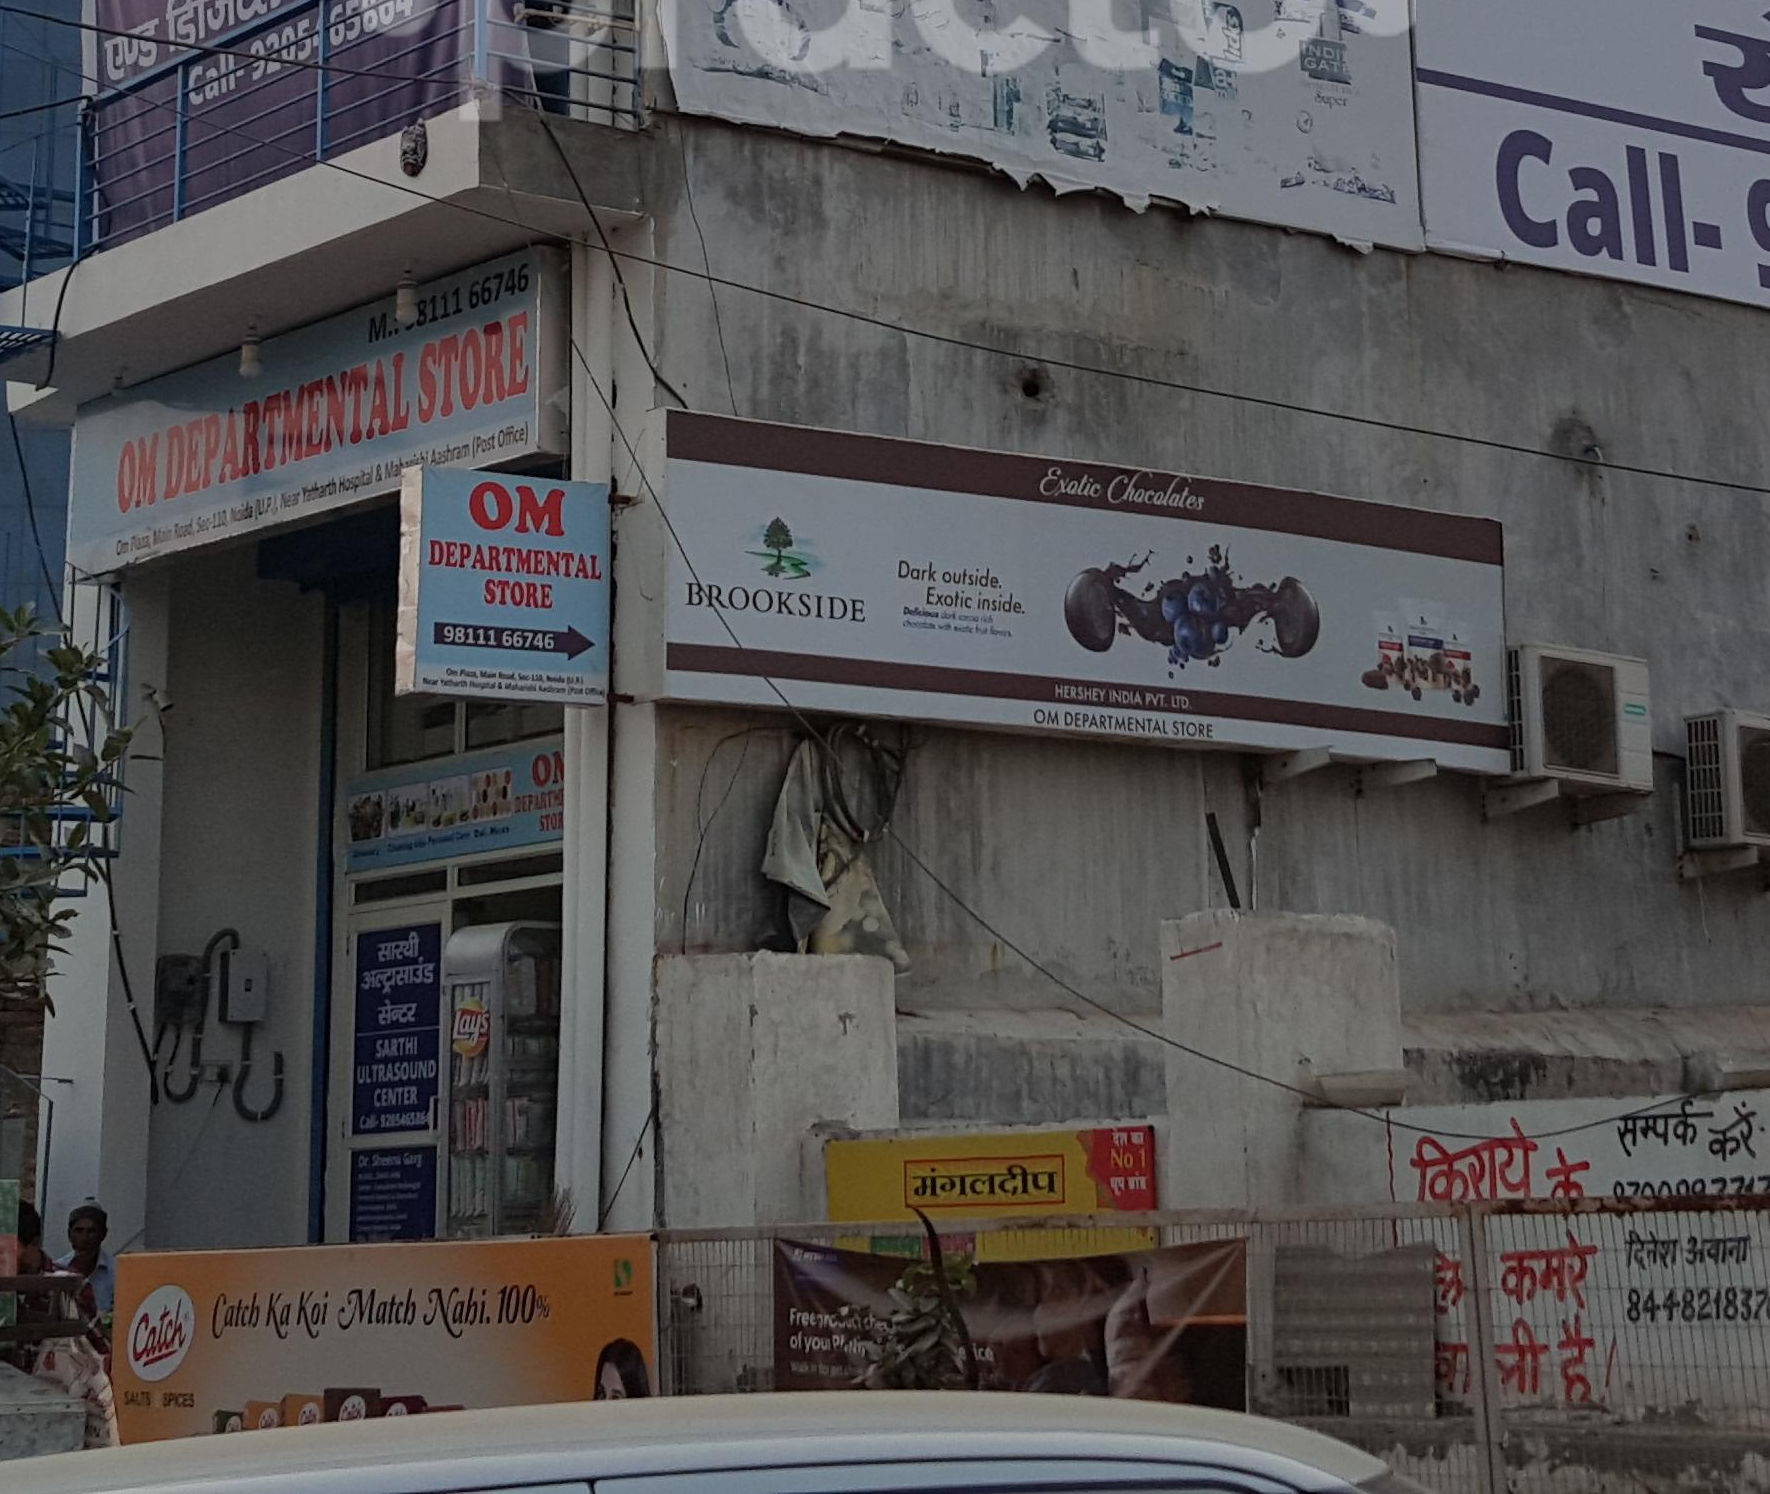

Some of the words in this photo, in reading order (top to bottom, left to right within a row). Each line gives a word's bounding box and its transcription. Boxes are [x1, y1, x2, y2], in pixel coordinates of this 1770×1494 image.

[188, 52, 245, 105] Call-
[1495, 130, 1721, 274] Call-
[405, 287, 463, 331] 8111
[469, 262, 529, 309] 66746
[116, 432, 158, 514] OM
[164, 352, 411, 501] DEPARTMENTAL
[417, 311, 529, 424] STORE
[280, 491, 300, 510] Near
[301, 478, 337, 503] Yatharth
[338, 467, 373, 494] Hospital
[375, 464, 383, 482] &
[430, 441, 470, 466] Aashram
[472, 434, 496, 459] (Post
[497, 421, 529, 448] Office)
[1039, 466, 1102, 498] Exotic
[1107, 469, 1206, 512] Chocolates
[469, 481, 566, 536] OM
[428, 539, 602, 580] DEPARTMENTAL
[898, 560, 936, 582] Dark
[942, 566, 1003, 589] outside.
[484, 578, 553, 608] STORE
[685, 582, 866, 623] BROOKSIDE
[926, 587, 973, 610] Exotic
[977, 590, 1025, 615] inside.
[443, 625, 497, 646] 98111
[502, 630, 555, 649] 66746
[1055, 684, 1107, 702] HERSHEY
[1109, 689, 1143, 706] INDIA
[1145, 692, 1167, 708] PVT.
[1171, 695, 1192, 711] LTD.
[1033, 709, 1060, 726] OM
[1064, 712, 1168, 735] DEPARTMENTAL
[1172, 720, 1214, 739] STORE
[539, 812, 564, 832] STOR
[375, 1036, 418, 1059] SARTHI
[357, 1059, 437, 1084] ULTRASOUND
[373, 1086, 418, 1108] CENTER
[1617, 1100, 1714, 1157] सम्पर्क
[1110, 1147, 1133, 1168] No
[1139, 1147, 1146, 1168] 1
[912, 1166, 1058, 1201] मंगलदीप
[1501, 1228, 1598, 1309] कमरे
[132, 1299, 186, 1362] Catch
[211, 1292, 259, 1339] Catch
[264, 1290, 291, 1340] Ka
[296, 1290, 329, 1339] Koi
[338, 1287, 416, 1331] Match
[423, 1285, 491, 1339] Nahi.
[497, 1284, 550, 1325] 100%
[124, 1391, 152, 1406] SALTS
[162, 1391, 196, 1408] SPICES
